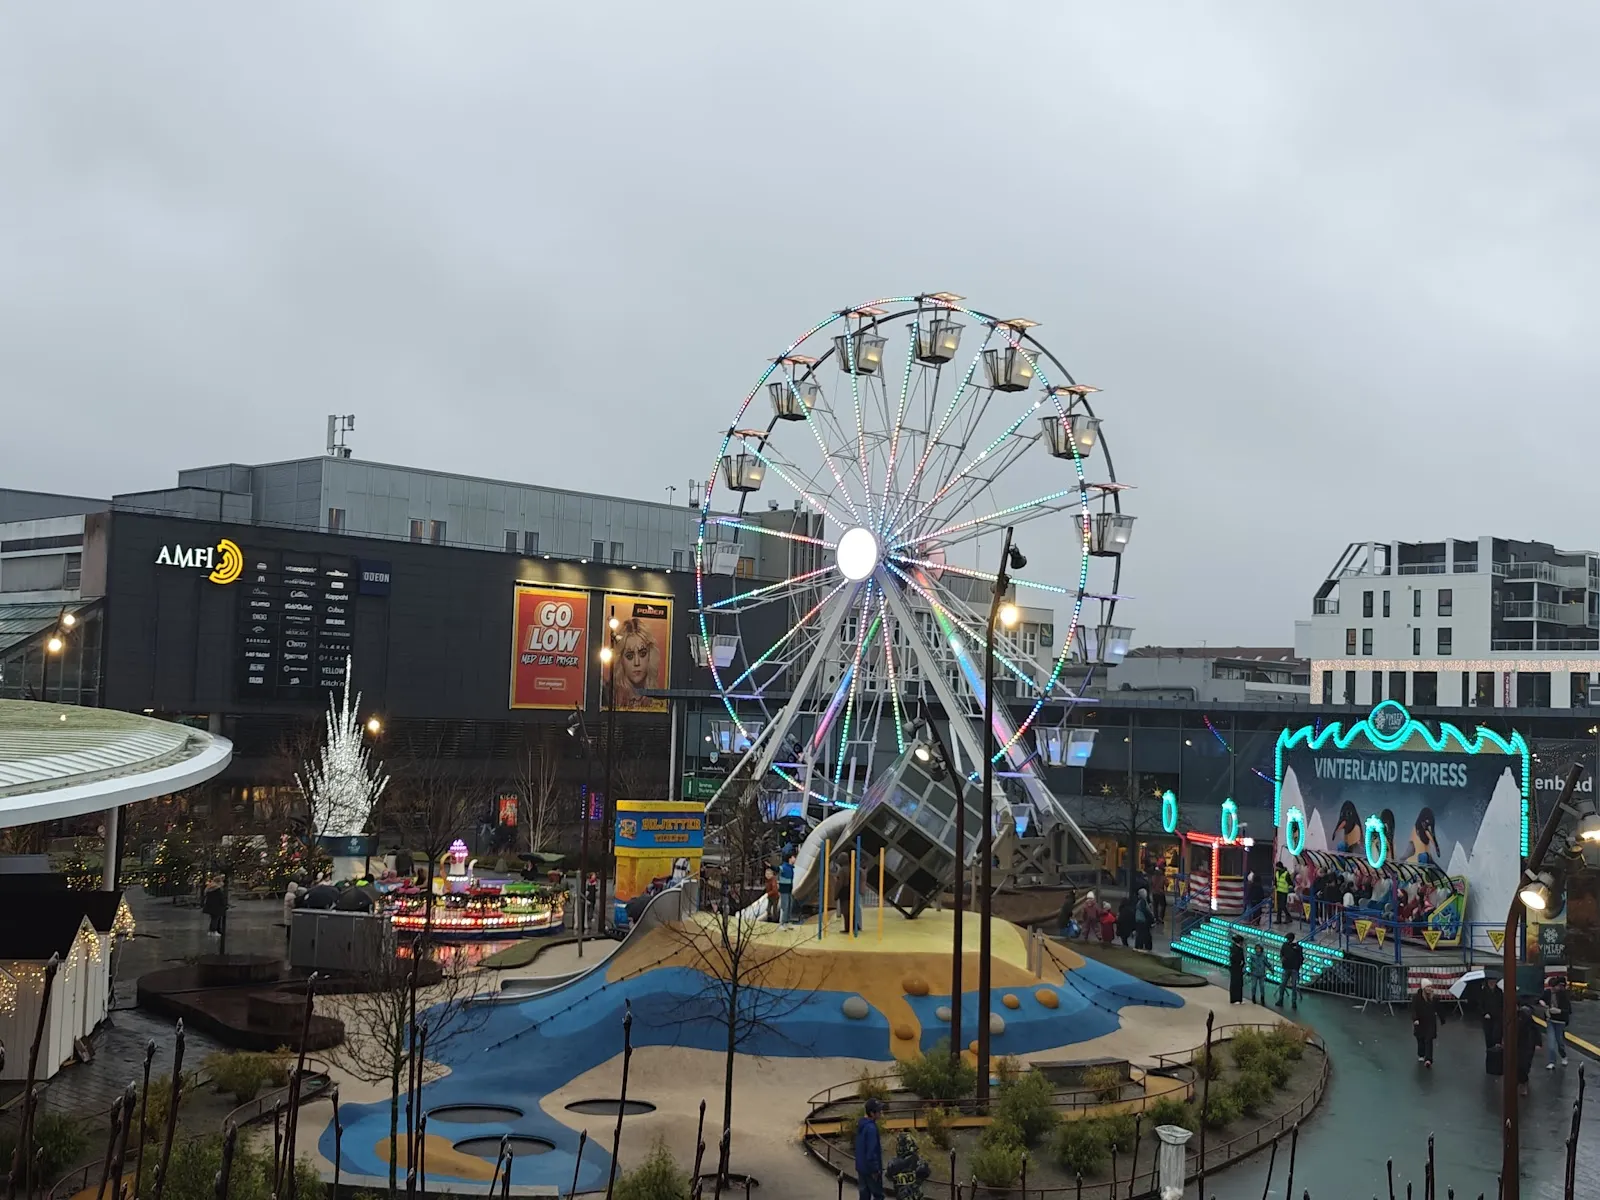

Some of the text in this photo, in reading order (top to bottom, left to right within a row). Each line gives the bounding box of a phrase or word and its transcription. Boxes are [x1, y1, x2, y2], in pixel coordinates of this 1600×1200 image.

[155, 543, 214, 569] AMFI
[363, 571, 390, 583] ODEON
[540, 602, 573, 628] GO
[636, 607, 665, 616] POWER
[529, 628, 581, 653] LOW
[321, 667, 345, 675] YELLOW
[1314, 757, 1468, 788] VINTERLAND EXPRESS
[1534, 775, 1593, 793] enbad
